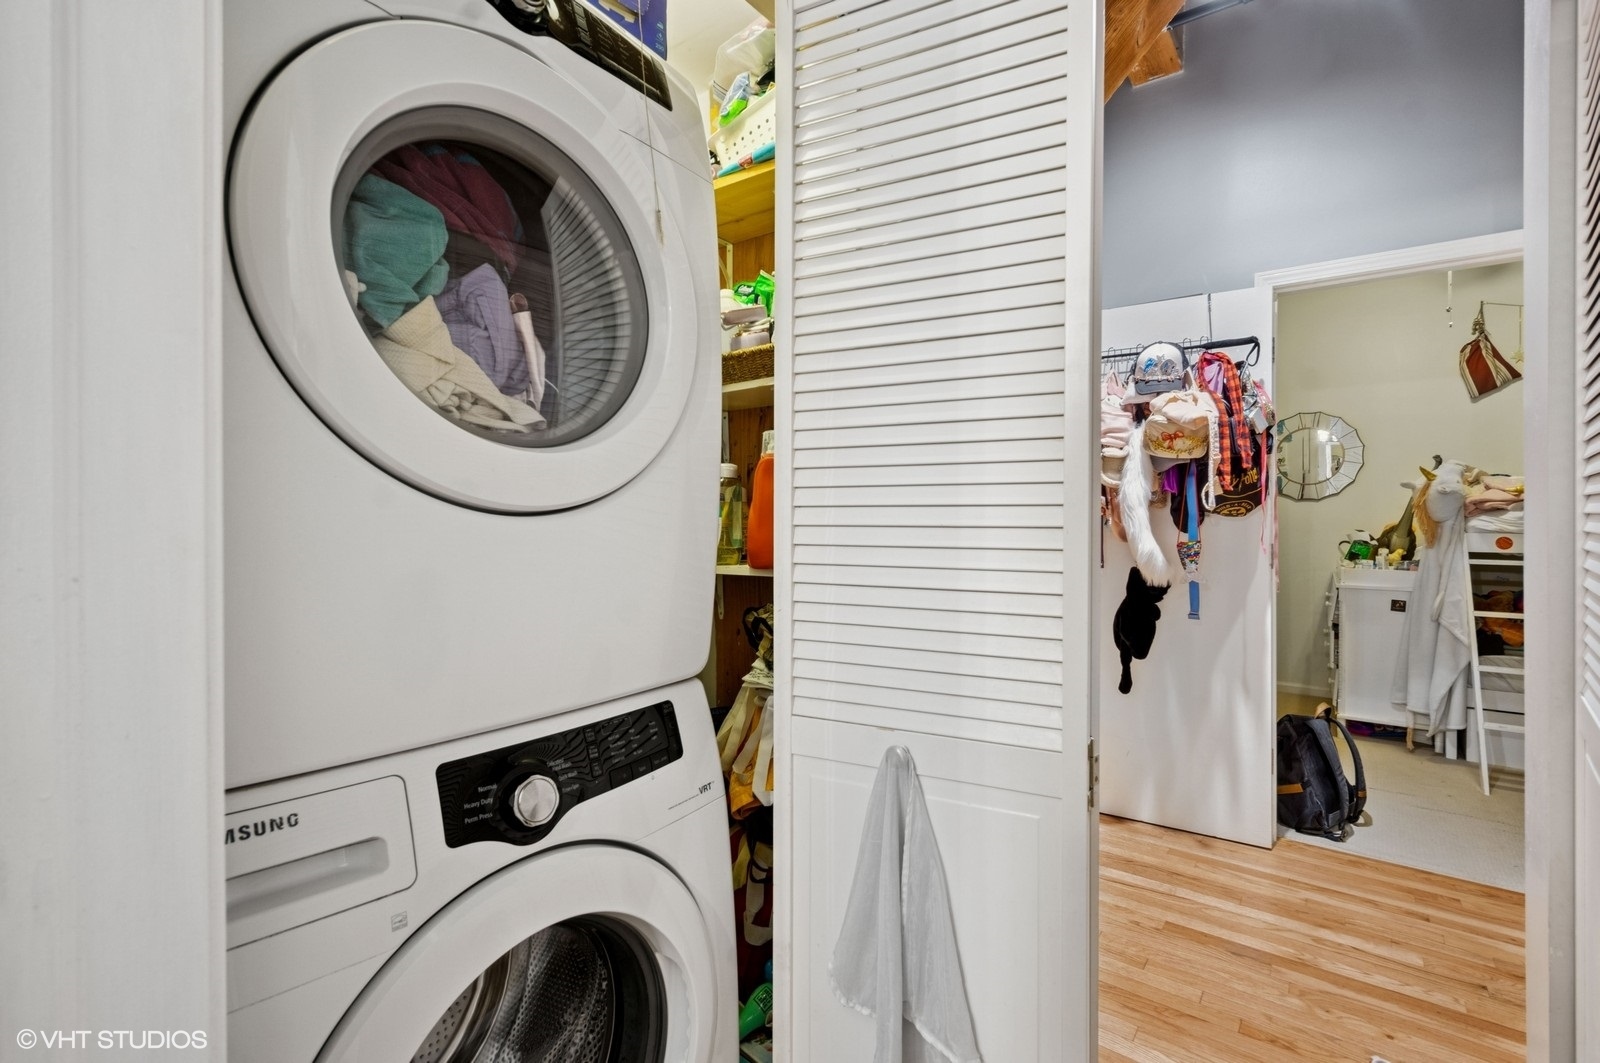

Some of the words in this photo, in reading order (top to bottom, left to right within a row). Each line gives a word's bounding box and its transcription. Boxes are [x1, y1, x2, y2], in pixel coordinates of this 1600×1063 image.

[477, 783, 497, 793] Normal
[463, 801, 480, 810] Heavy
[480, 797, 494, 805] Duty
[464, 816, 479, 824] Perm
[479, 812, 493, 820] Press
